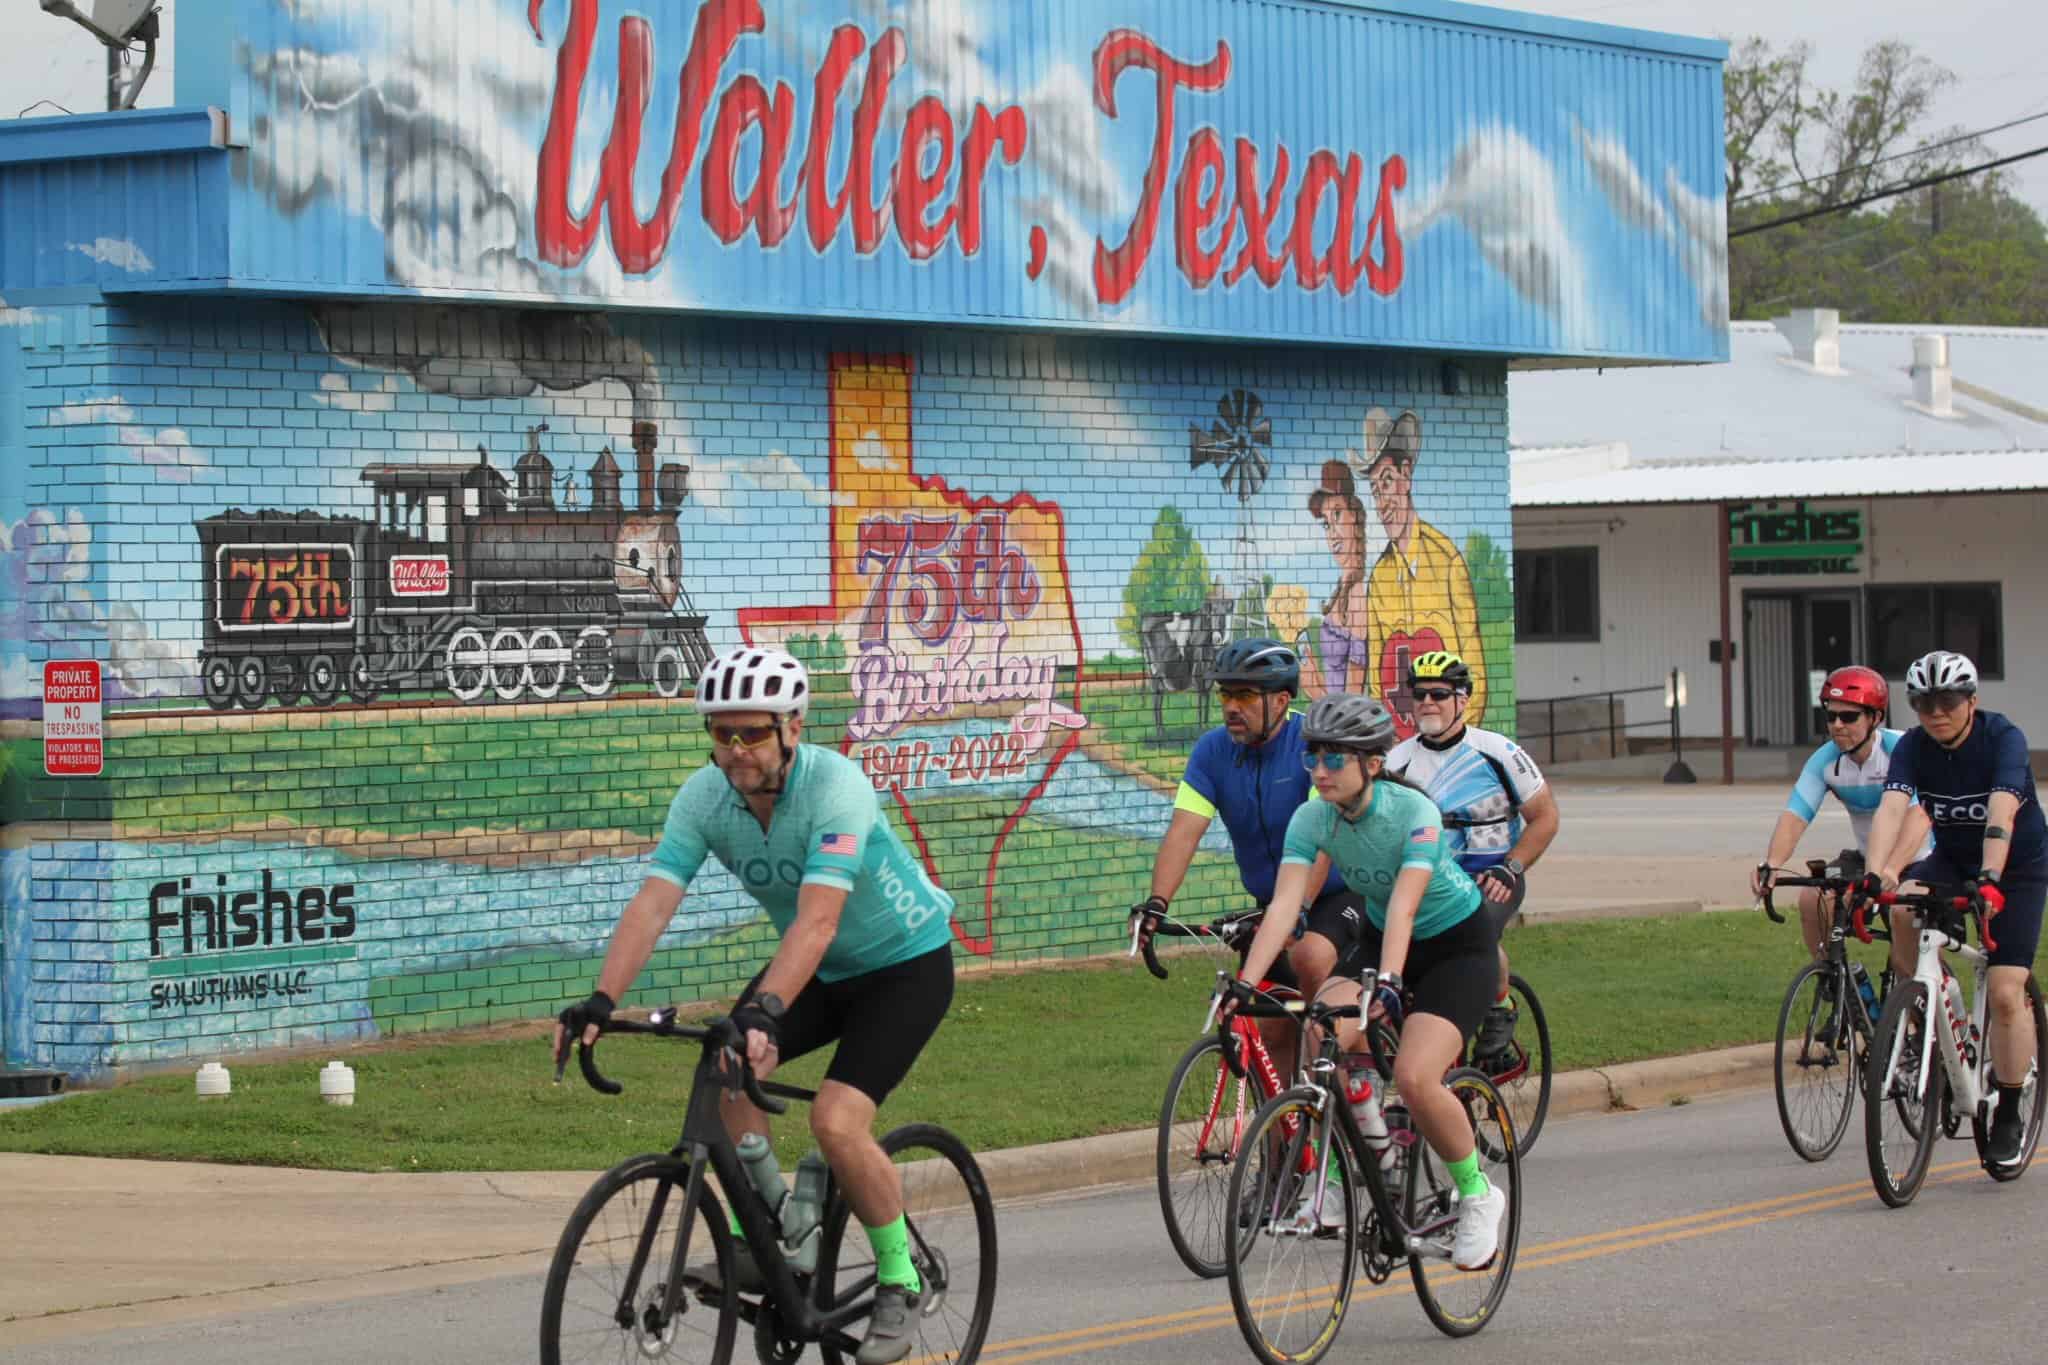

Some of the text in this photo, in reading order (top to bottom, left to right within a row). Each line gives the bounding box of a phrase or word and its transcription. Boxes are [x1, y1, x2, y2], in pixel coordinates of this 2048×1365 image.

[1093, 28, 1407, 304] Texas
[395, 562, 454, 588] Waller
[856, 511, 1041, 648] 75th
[230, 552, 349, 624] 75th
[52, 670, 92, 684] PRIVATE
[848, 618, 1089, 756] Birthday
[47, 686, 97, 699] PROPERTY
[64, 705, 81, 720] NO
[47, 722, 100, 736] TRESPASSING
[48, 743, 99, 753] VIOLATORS WILL
[59, 755, 99, 765] PROSECUTED
[151, 972, 268, 1010] SOLUTIONS
